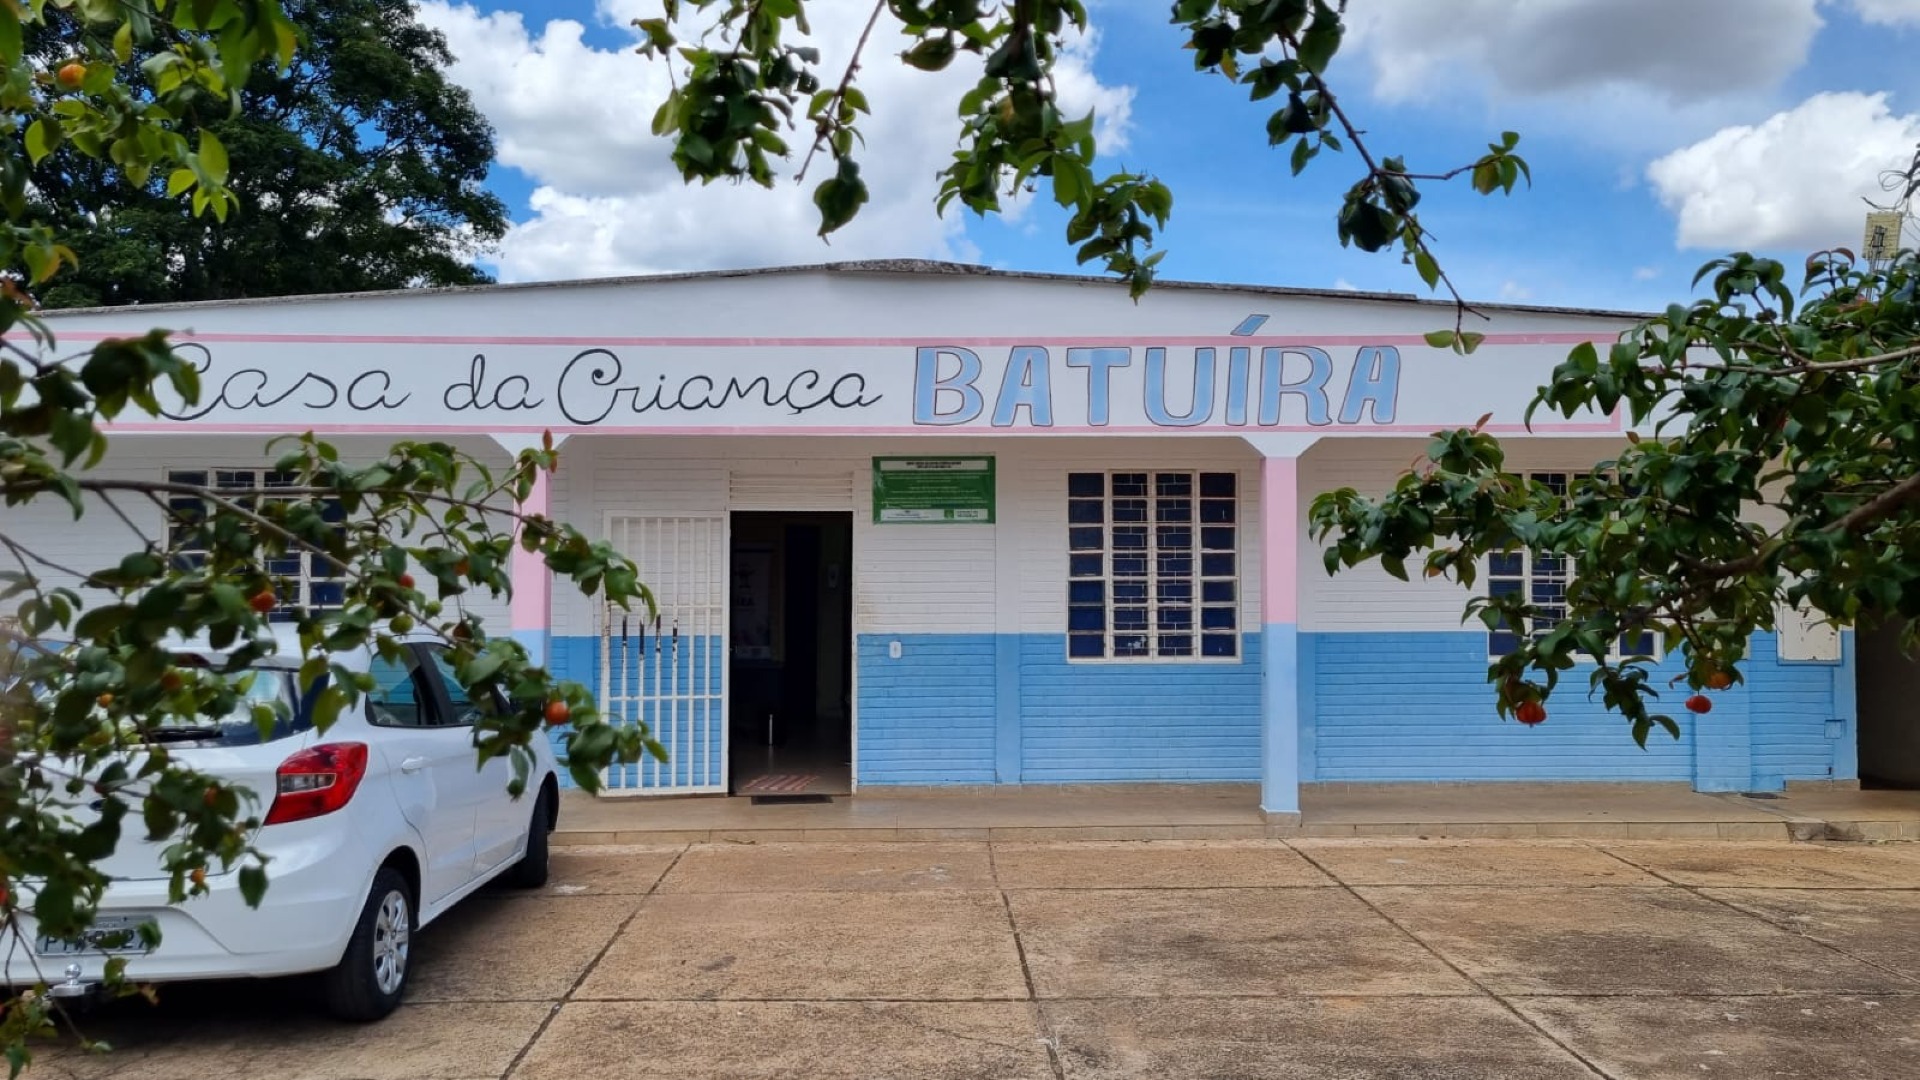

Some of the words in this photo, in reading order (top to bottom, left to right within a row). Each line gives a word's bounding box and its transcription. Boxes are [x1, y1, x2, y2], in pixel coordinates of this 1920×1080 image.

[150, 342, 412, 421] Casa
[443, 353, 545, 411] da
[557, 348, 883, 425] Criança
[912, 313, 1401, 428] BATUÍRA
